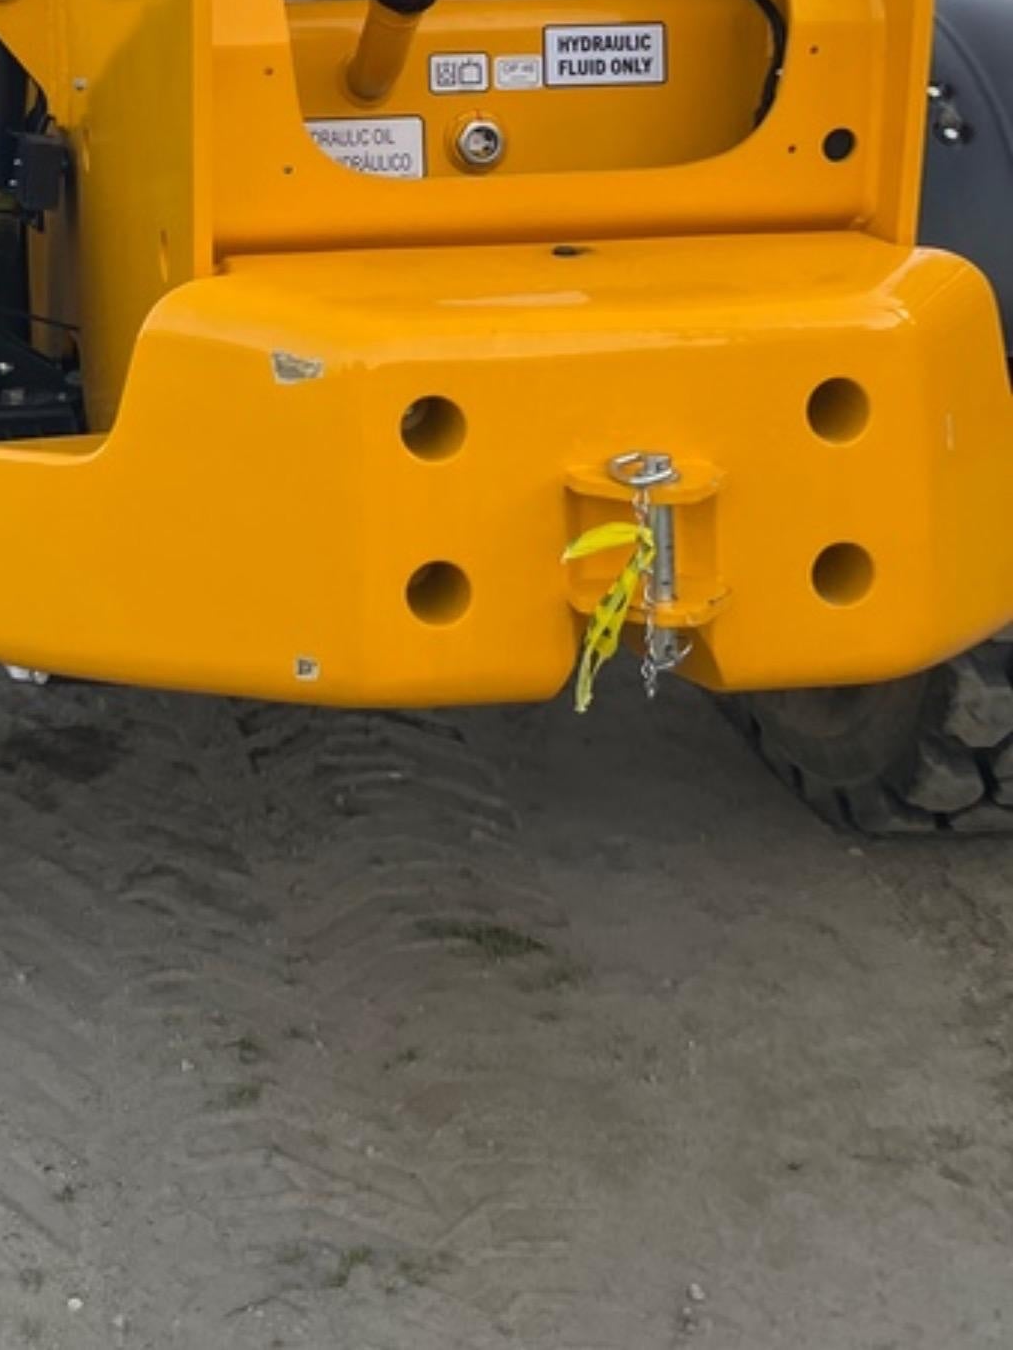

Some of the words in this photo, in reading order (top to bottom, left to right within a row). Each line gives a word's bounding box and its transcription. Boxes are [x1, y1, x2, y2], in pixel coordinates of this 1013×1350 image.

[557, 33, 651, 53] HYDRAULIC
[558, 59, 606, 76] FLUID
[611, 57, 653, 74] ONLY
[372, 128, 395, 144] OIL
